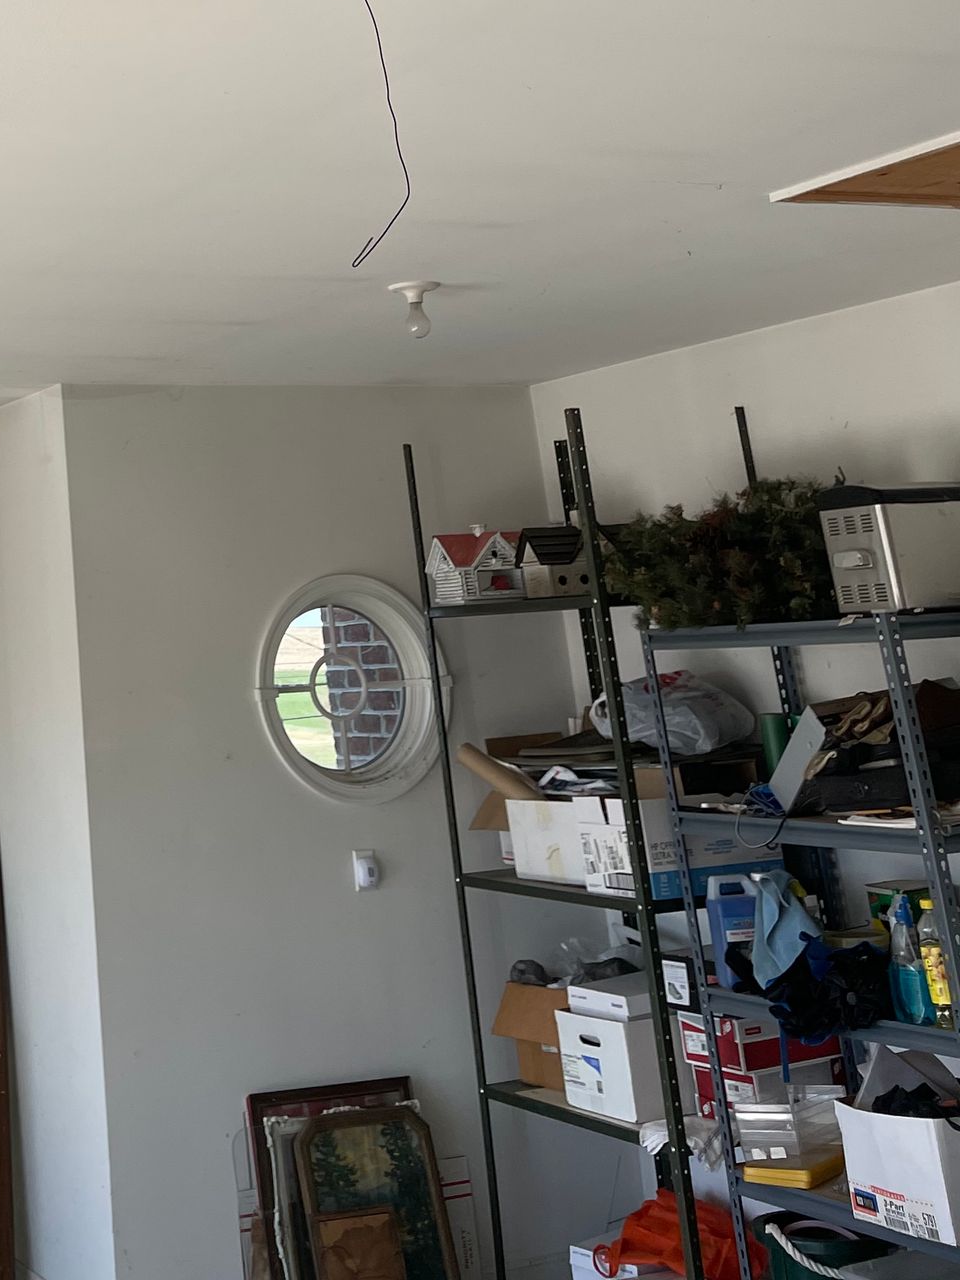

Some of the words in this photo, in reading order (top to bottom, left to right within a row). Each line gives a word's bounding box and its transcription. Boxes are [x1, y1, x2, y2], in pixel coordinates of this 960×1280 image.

[871, 1187, 905, 1201] PERFORATED
[884, 1199, 904, 1212] 3-Part
[922, 1212, 937, 1228] 5791
